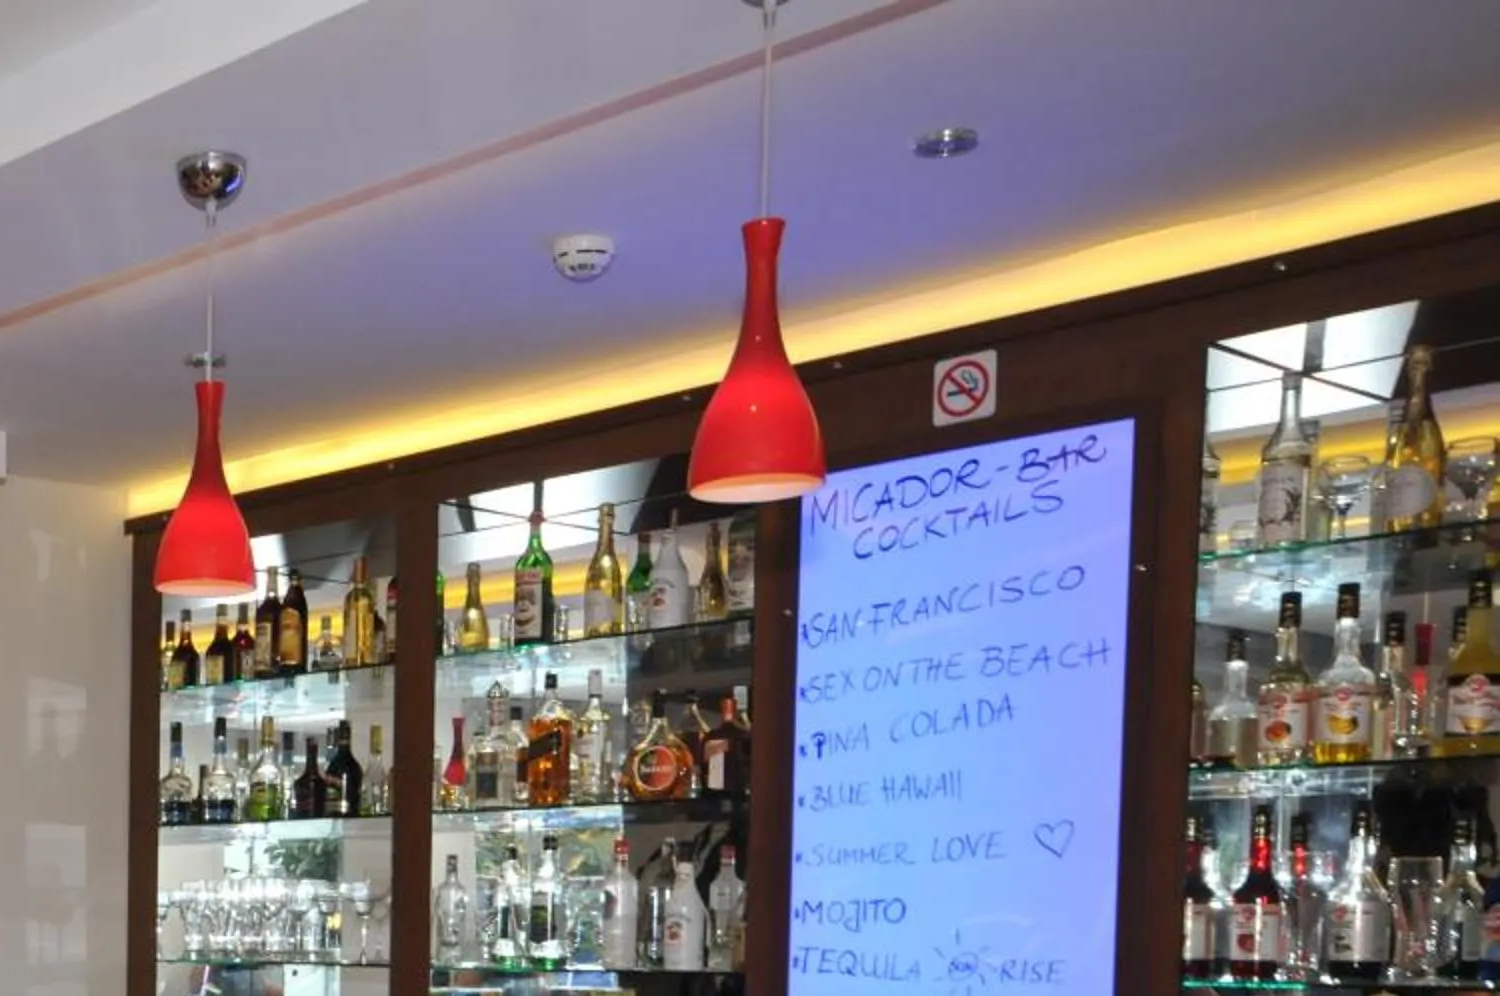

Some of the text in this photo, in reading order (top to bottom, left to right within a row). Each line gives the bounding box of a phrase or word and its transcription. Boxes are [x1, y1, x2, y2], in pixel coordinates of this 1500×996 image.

[853, 479, 1065, 559] COCKTAILS
[867, 565, 1085, 634] FRANCISCO
[805, 669, 854, 703] SEX
[910, 652, 964, 685] THE
[979, 637, 1110, 679] BEACH
[811, 693, 1015, 760] PINA COLADA
[809, 768, 962, 812] BLUE HAWAII
[806, 831, 1007, 867] SUMMER LOVE
[801, 897, 907, 933] MOJITO
[798, 946, 921, 981] TEQUILA
[999, 958, 1066, 984] RISE
